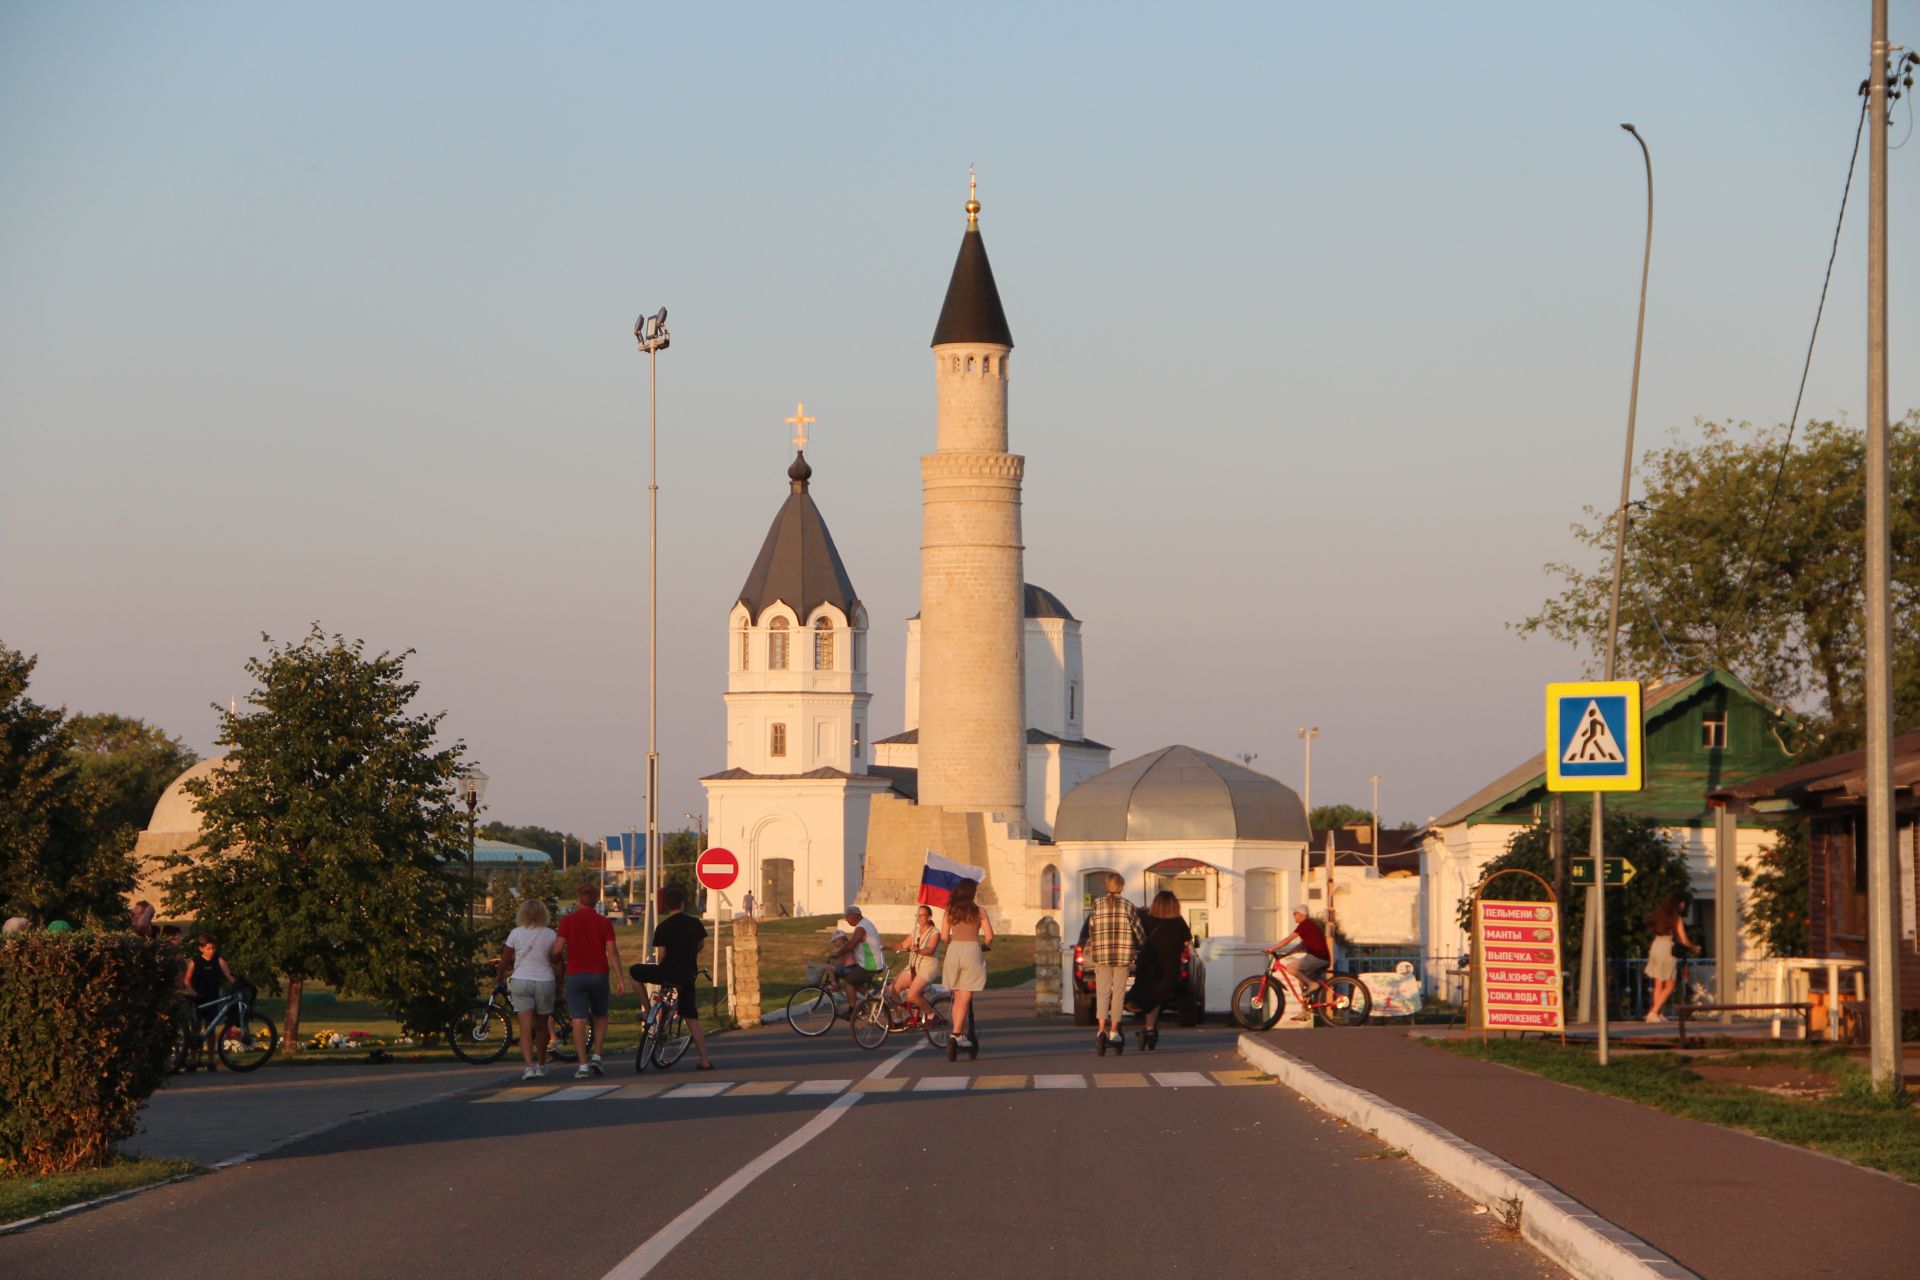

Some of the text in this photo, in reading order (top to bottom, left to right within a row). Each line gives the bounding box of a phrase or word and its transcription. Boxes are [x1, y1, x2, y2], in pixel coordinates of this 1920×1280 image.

[1486, 908, 1533, 919] ПЕЛЬМЕНИ
[1487, 930, 1522, 940] МАНТЫ
[1488, 951, 1532, 961] ВЫПЕЧКА
[1491, 1013, 1542, 1024] МОРОЖЕНОЕ
